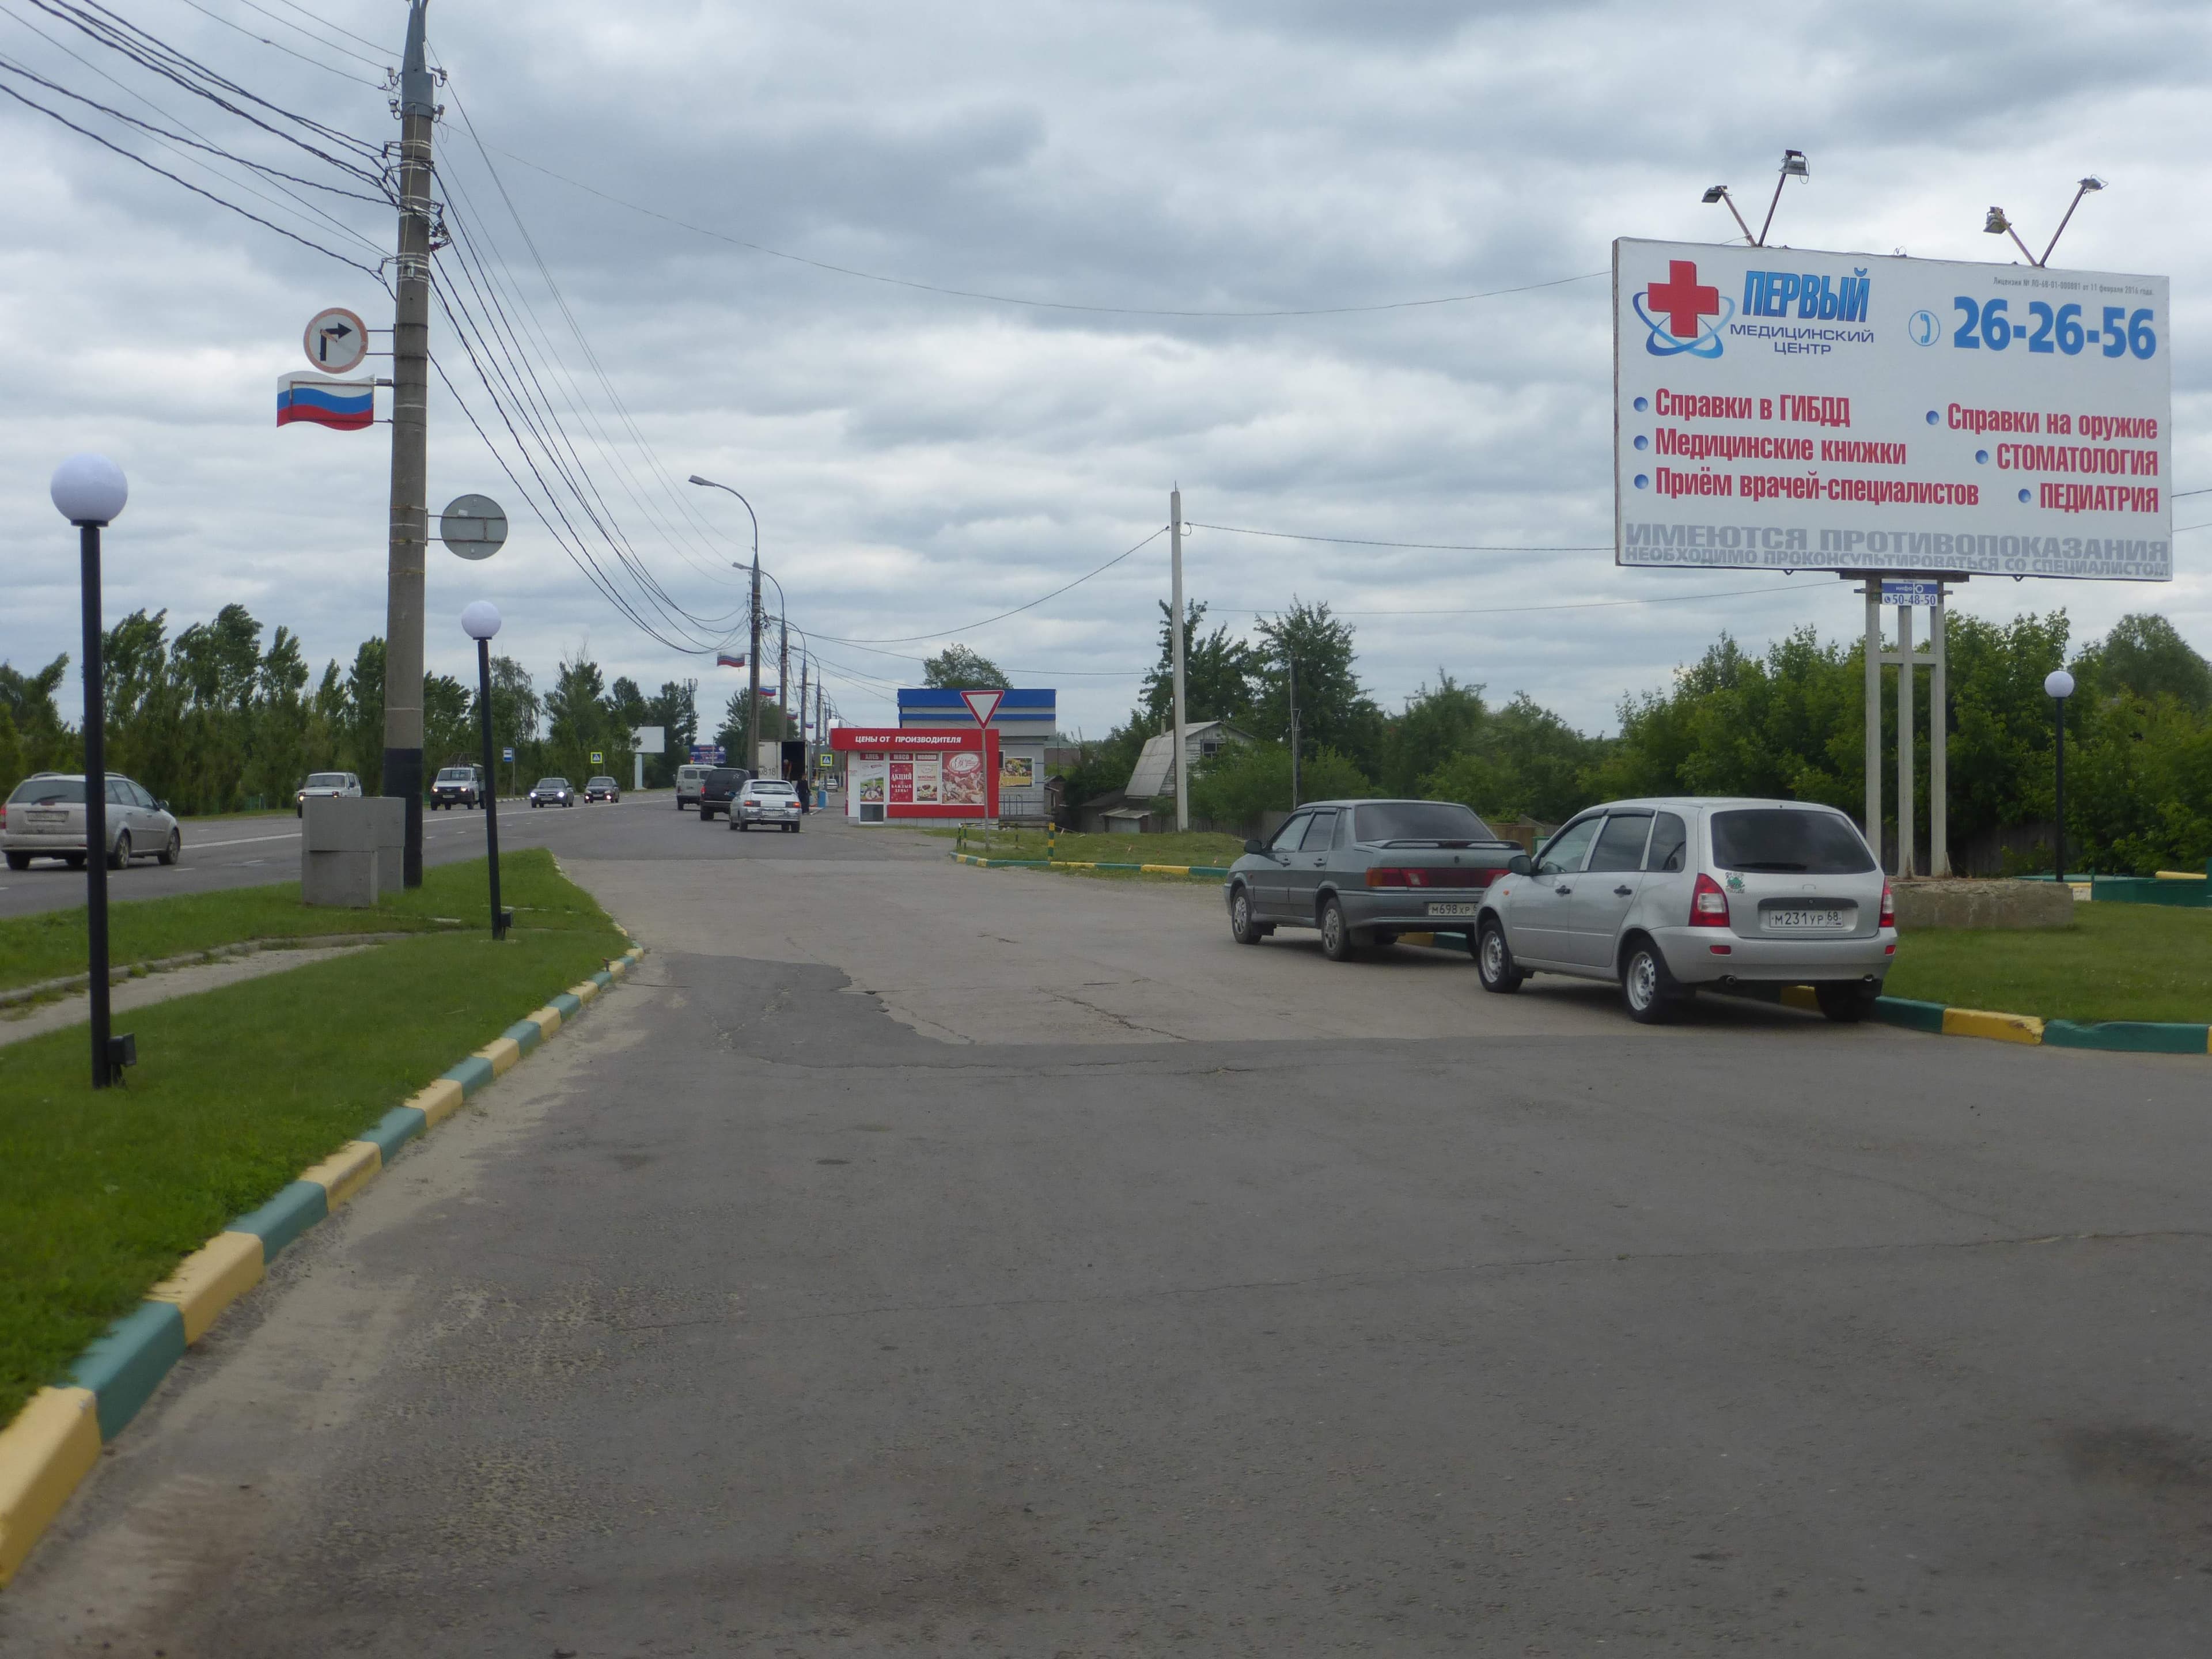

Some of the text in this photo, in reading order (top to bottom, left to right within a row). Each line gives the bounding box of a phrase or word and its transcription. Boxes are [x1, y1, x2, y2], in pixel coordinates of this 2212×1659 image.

[1743, 267, 1870, 323] ПЕРВЫЙ
[1730, 324, 1874, 343] МЕДИЦИНСКИЙ
[1954, 296, 2156, 359] 26-26-56
[1774, 342, 1831, 355] ЦЕНТР
[1656, 388, 1850, 427] Справки в ГИБДД
[1948, 403, 2157, 441] Справки на оружие
[1656, 427, 1906, 464] Медицинские книжки
[1997, 443, 2158, 476] СТОМАТОЛОГИЯ
[1656, 467, 1979, 506] Приём врачей-специалистов
[2040, 483, 2158, 513] ПЕДИАТРИЯ
[1626, 523, 2168, 562] ИМЕЮТСЯ ПРОТИВОПОКАЗАНИЯ
[1626, 547, 2169, 576] НЕОБХОДИМО ПРОКОНСУЛЬТИРОВАТЬСЯ СО СПЕЦИАЛИСТОМ
[1892, 594, 1936, 605] 50-48-50
